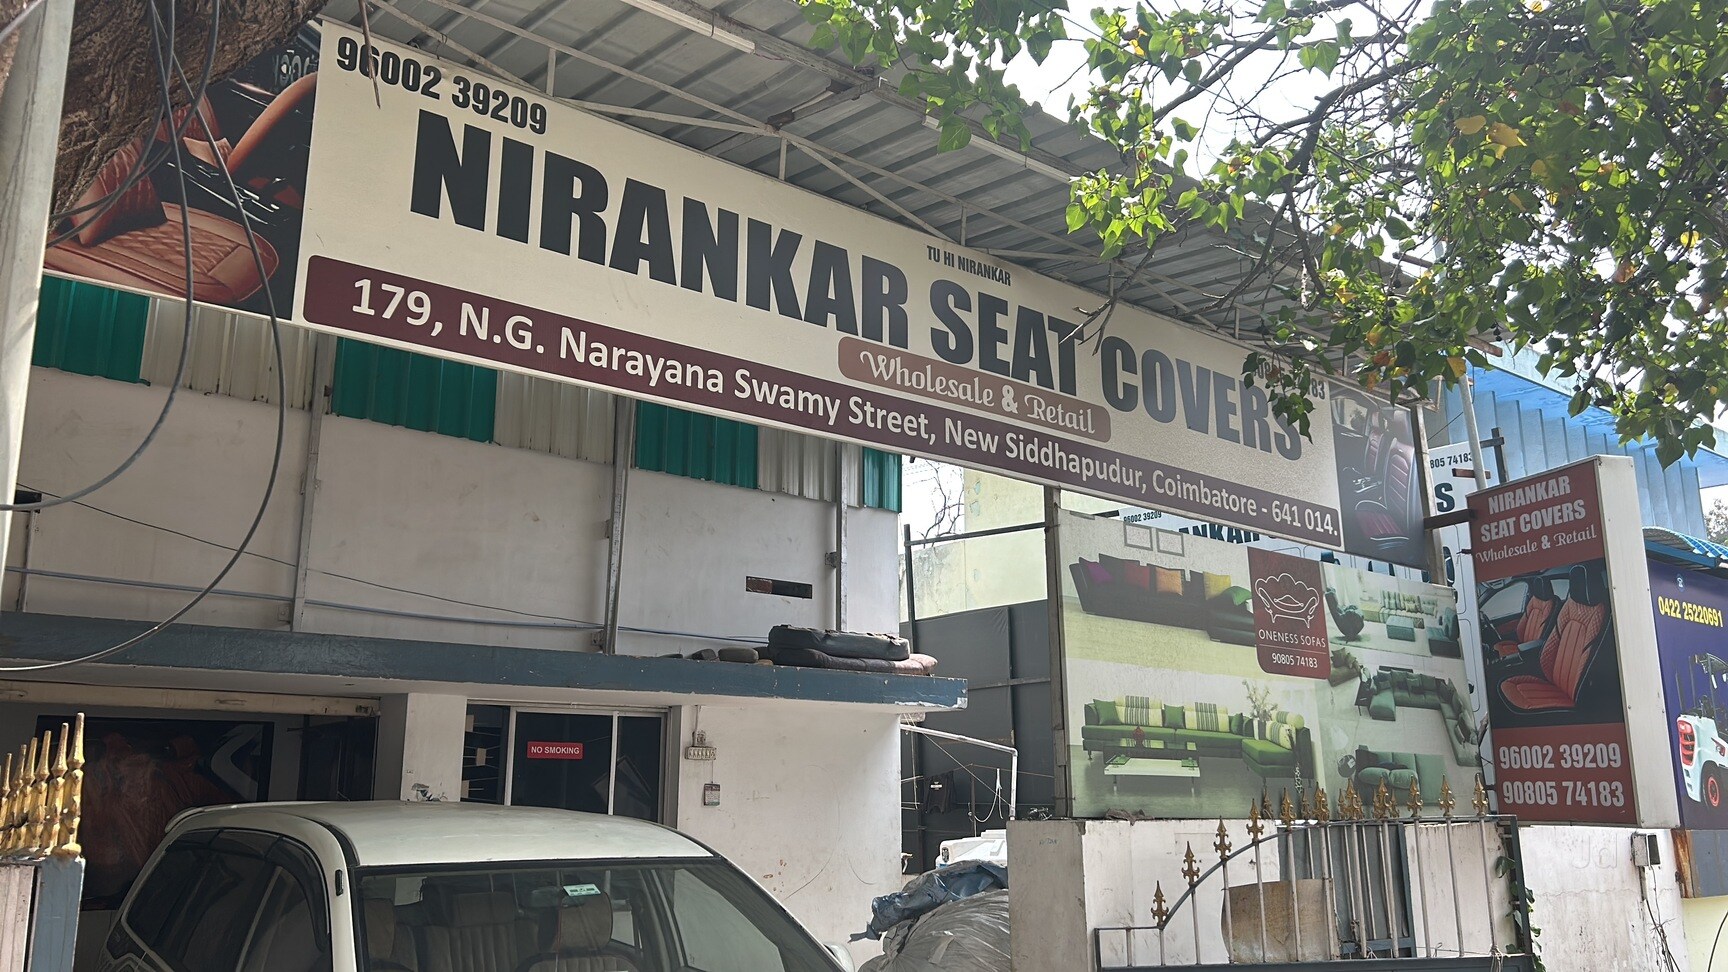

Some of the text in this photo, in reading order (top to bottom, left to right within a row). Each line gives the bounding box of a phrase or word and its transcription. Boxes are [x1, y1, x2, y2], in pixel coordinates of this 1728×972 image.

[337, 36, 442, 100] 96002
[451, 75, 547, 135] 39209
[410, 108, 1302, 461] NIRANKAR SEAT COVERS
[926, 245, 1011, 287] TU HI NIRANKAR
[352, 278, 443, 337] 179,
[459, 302, 545, 354] N.G.
[560, 326, 724, 394] Narayana
[734, 369, 841, 426] Swamy
[848, 396, 936, 446] Street,
[945, 417, 999, 454] New
[1005, 432, 1147, 494] Siddhapudur,
[1152, 469, 1257, 517] Coimbatore
[1271, 500, 1302, 528] 641
[1304, 508, 1338, 536] 014.
[859, 350, 1096, 435] Wholesale & Retail
[1488, 475, 1571, 515] NIRANKAR
[1480, 499, 1586, 543] SEAT COVERS
[1475, 524, 1597, 563] Wholesale & Retail
[1657, 596, 1723, 628] 0422 25220691
[1258, 629, 1326, 648] ONENESS SOFAS
[1272, 653, 1318, 668] 90805 74183
[531, 746, 580, 755] NO SMOKING
[1500, 743, 1622, 769] 96002 39209
[1503, 781, 1625, 807] 90805 74183
